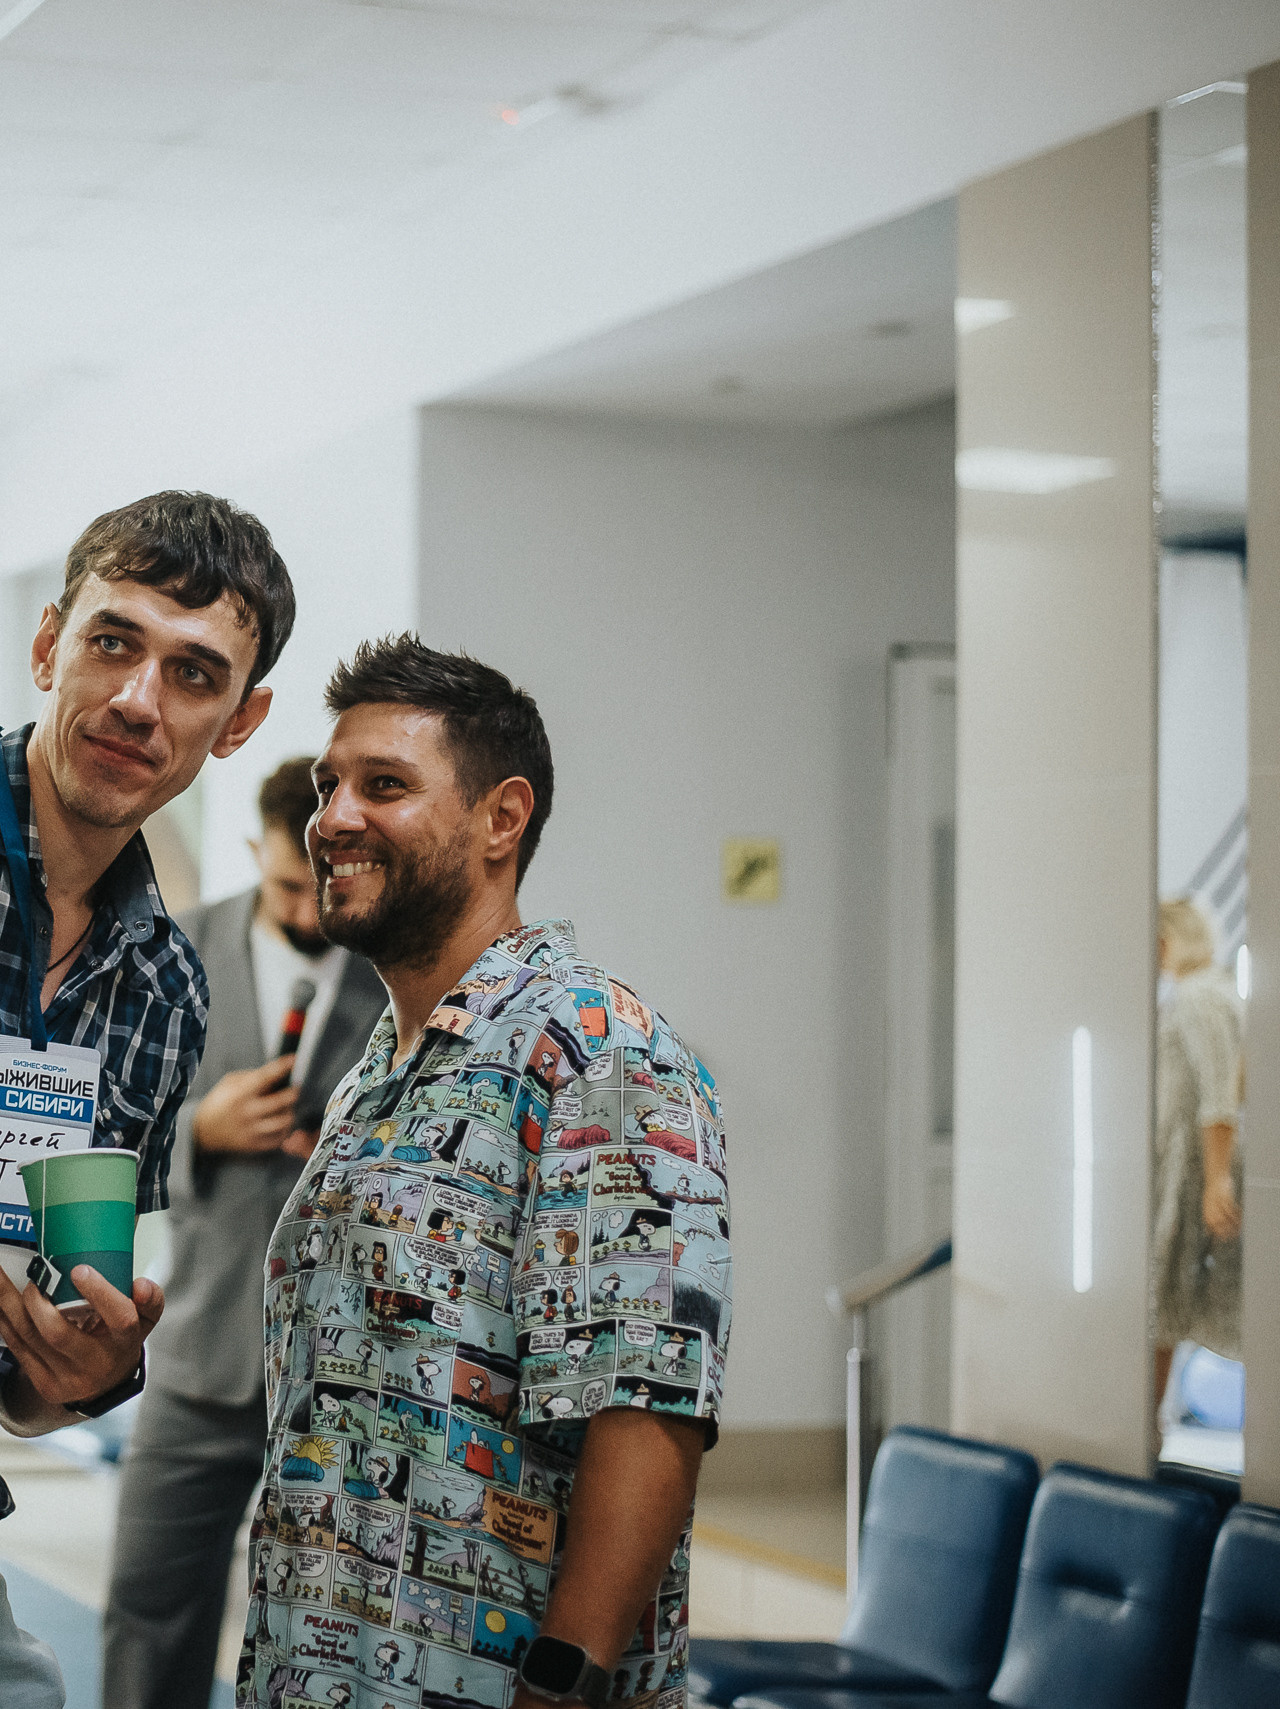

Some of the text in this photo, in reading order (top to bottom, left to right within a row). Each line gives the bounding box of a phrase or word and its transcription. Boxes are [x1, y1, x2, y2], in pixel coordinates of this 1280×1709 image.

[13, 1059, 68, 1074] БИЗНЕС-ФОРУМ
[5, 1090, 85, 1118] СИБИРИ
[596, 1153, 657, 1167] PEANUTS
[492, 1491, 548, 1522] PEANUTS
[304, 1615, 359, 1638] PEANUTS
